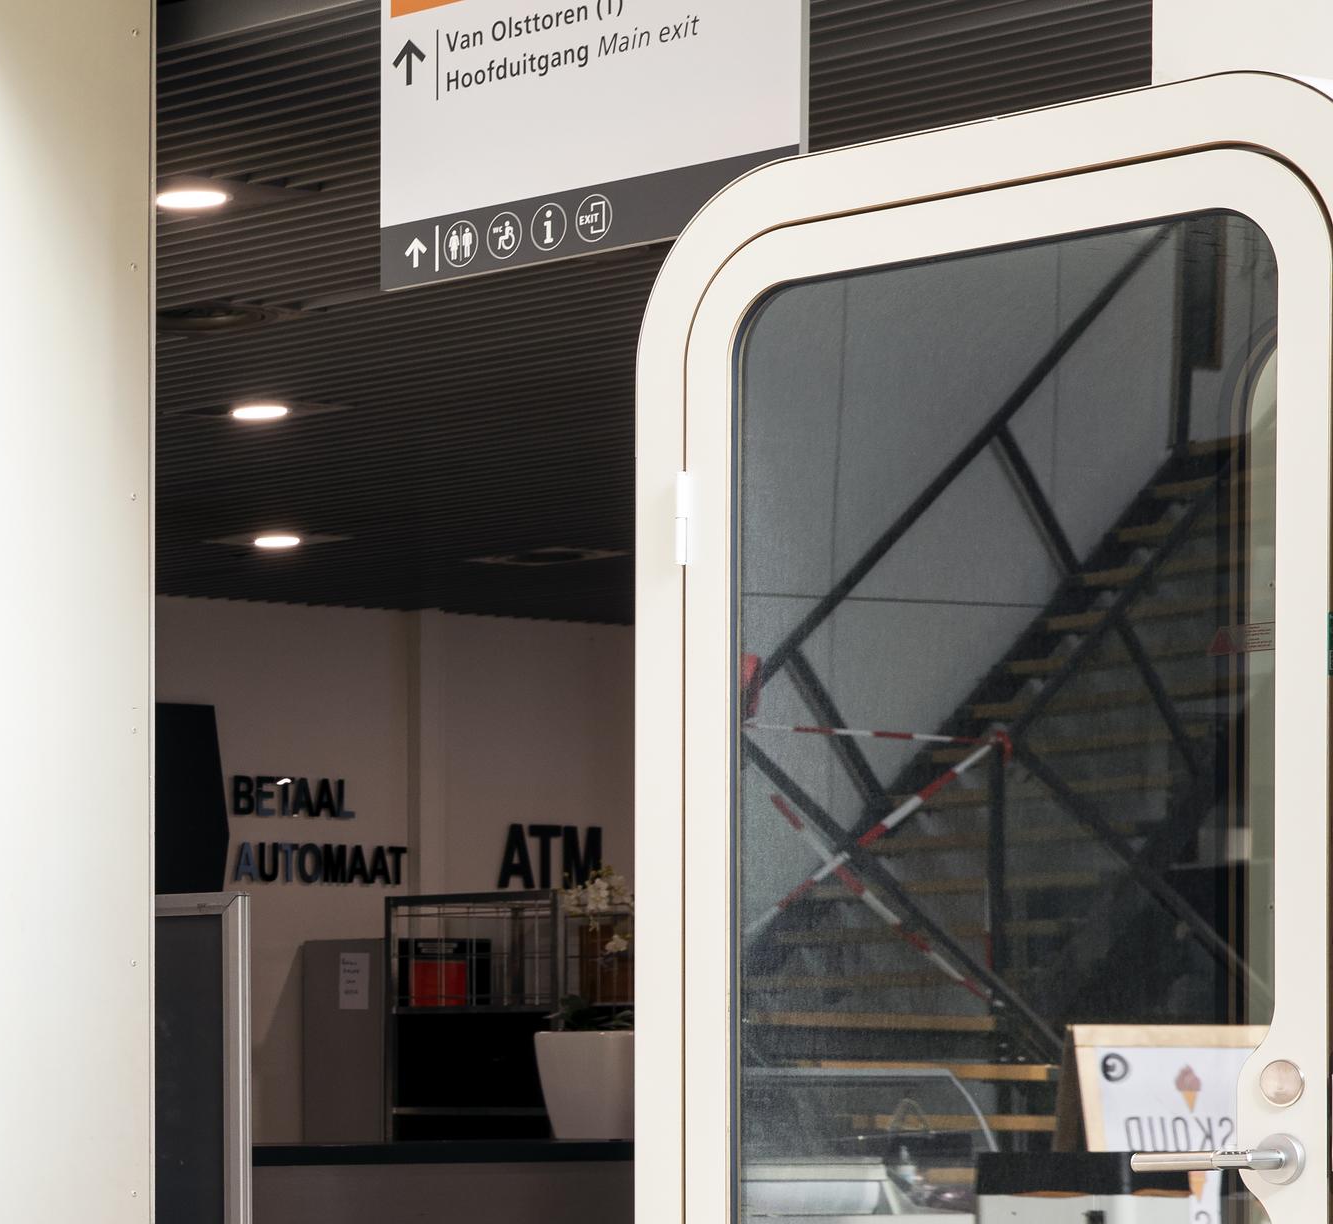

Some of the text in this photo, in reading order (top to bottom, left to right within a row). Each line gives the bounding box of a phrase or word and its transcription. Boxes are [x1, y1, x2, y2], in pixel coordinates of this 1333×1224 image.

[446, 30, 483, 52] Van
[491, 4, 588, 42] Olsttoren
[446, 15, 700, 92] Hoofduitgang Main exit
[579, 212, 600, 226] EXIT
[232, 775, 356, 819] BETAAL
[234, 842, 407, 886] AUTOMAAT
[497, 823, 603, 890] ATM
